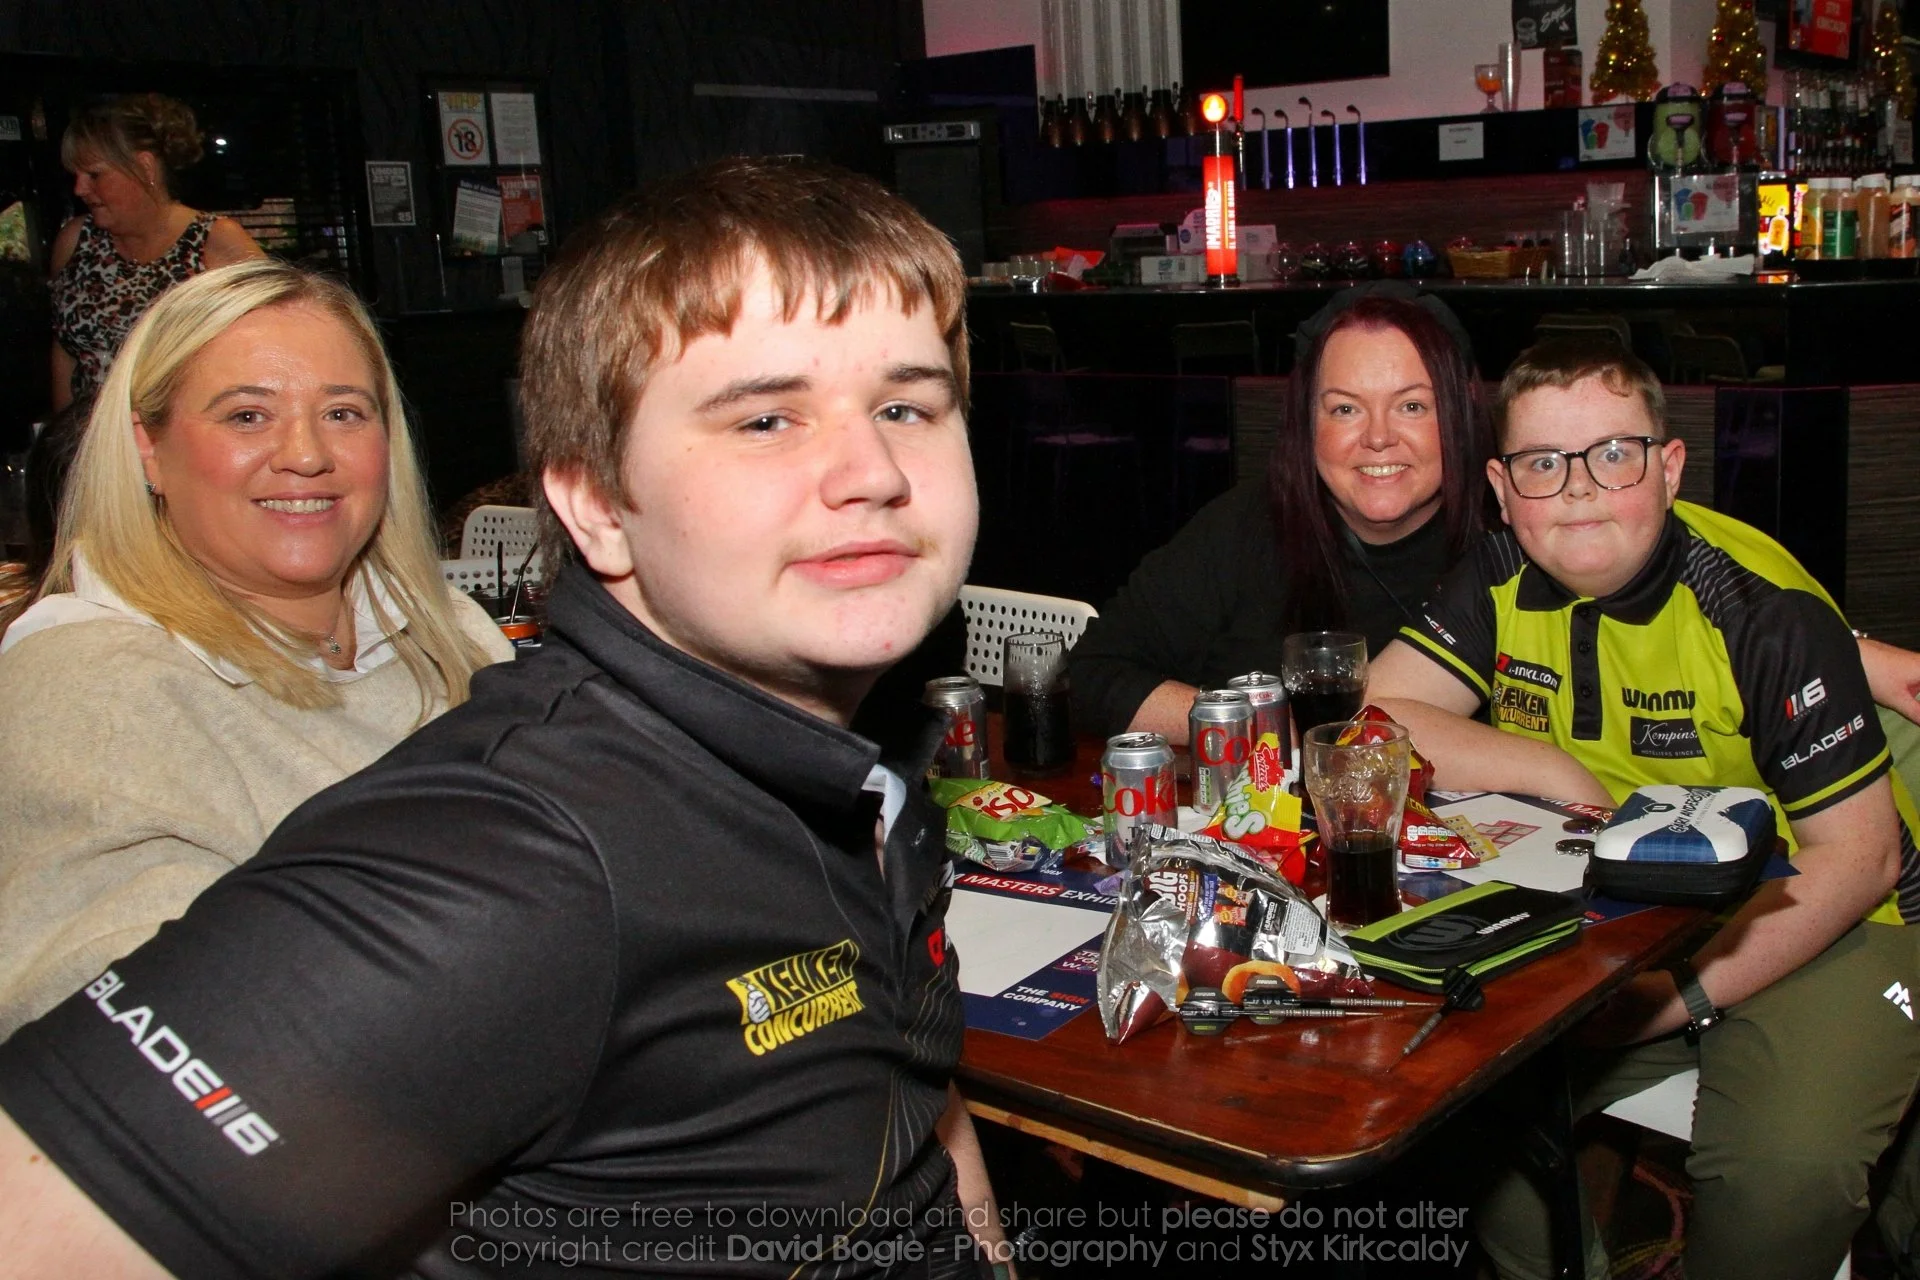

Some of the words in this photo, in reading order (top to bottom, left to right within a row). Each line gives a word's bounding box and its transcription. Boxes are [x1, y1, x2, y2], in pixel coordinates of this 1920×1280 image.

[454, 131, 477, 152] 18
[1632, 722, 1698, 748] Kempins
[964, 874, 1061, 897] MASTERS
[1176, 873, 1188, 911] HOOPS
[1002, 992, 1083, 1011] COMPANY
[1016, 985, 1049, 997] THE
[1050, 992, 1090, 1005] SIGN
[744, 980, 866, 1057] CONCURRENT
